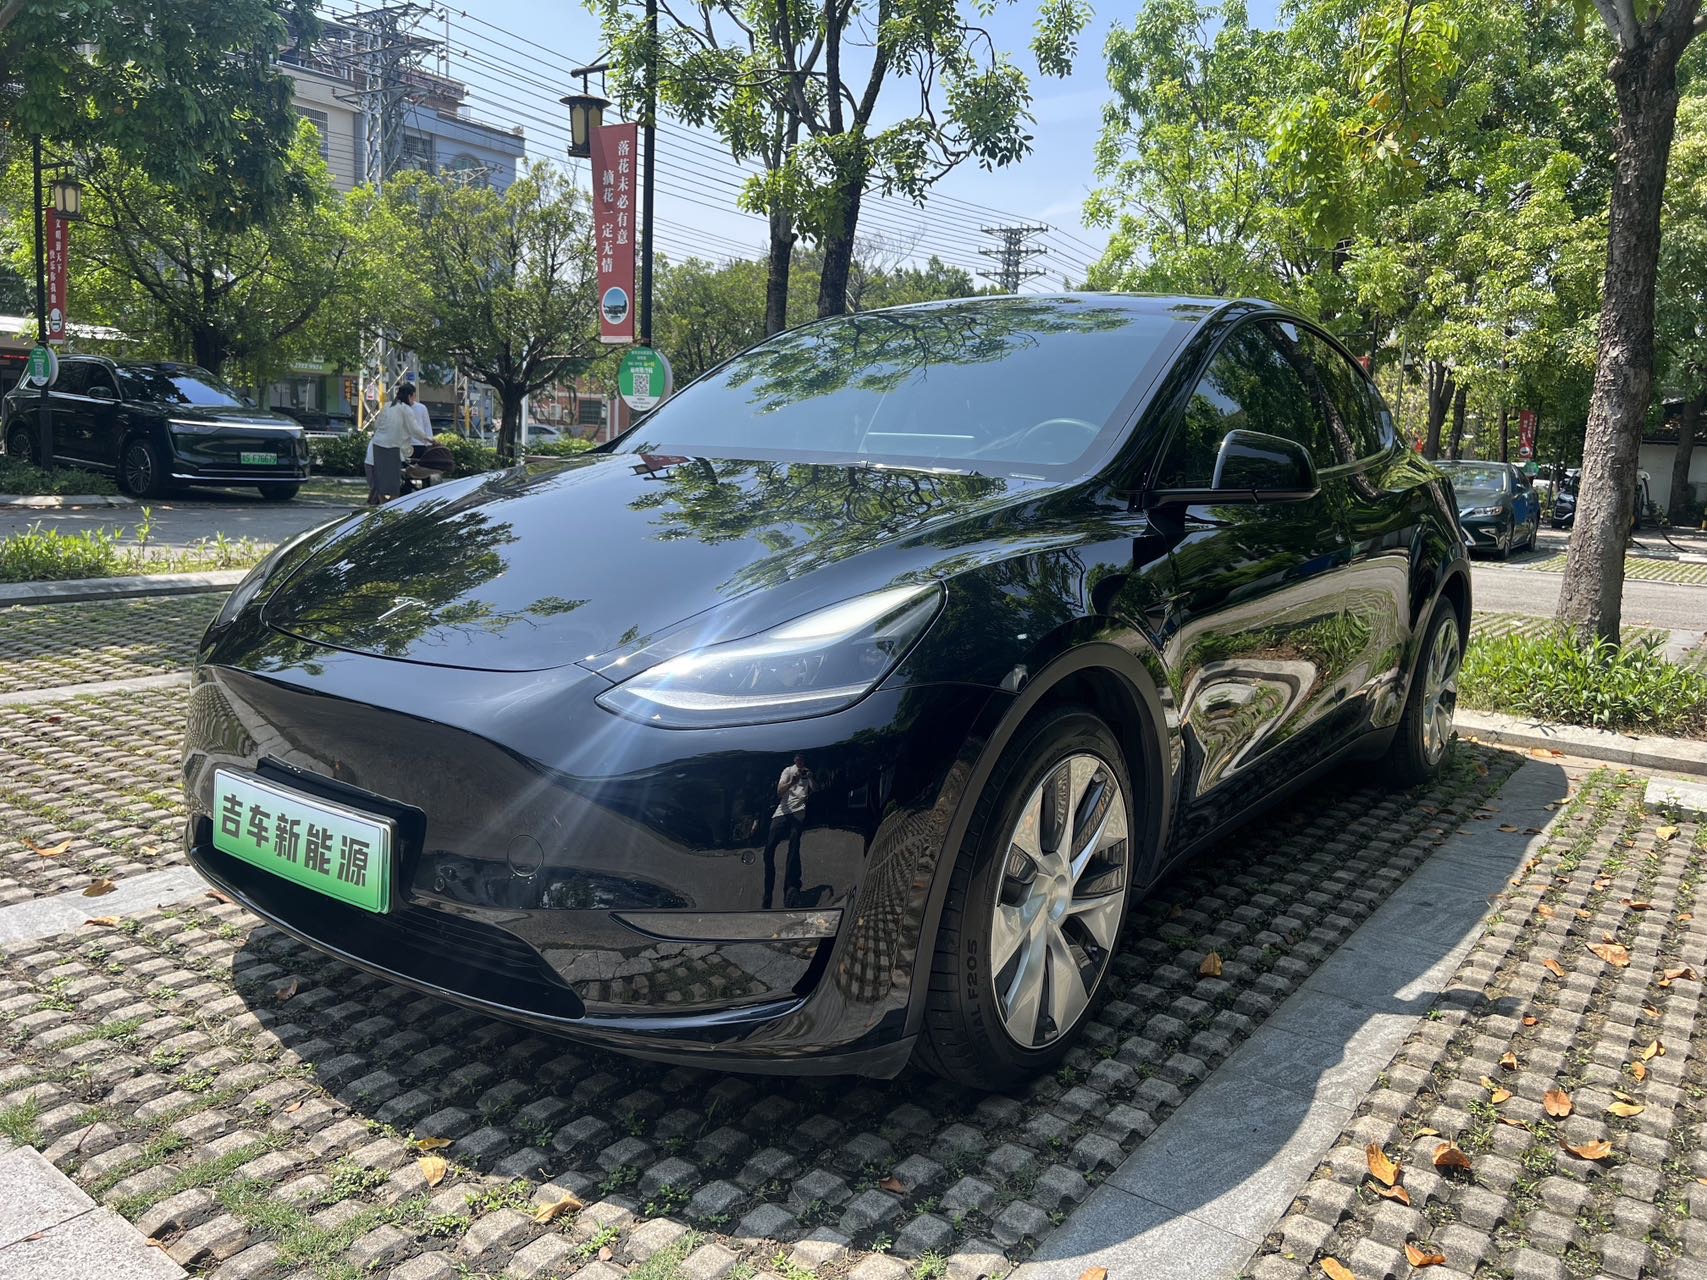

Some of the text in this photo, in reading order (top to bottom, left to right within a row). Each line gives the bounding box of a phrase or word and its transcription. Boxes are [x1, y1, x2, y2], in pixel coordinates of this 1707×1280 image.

[602, 169, 615, 273] 摘花一定无情
[617, 140, 630, 245] 落花未必有意
[221, 793, 370, 888] 吉车新能源
[967, 939, 979, 1000] F205
